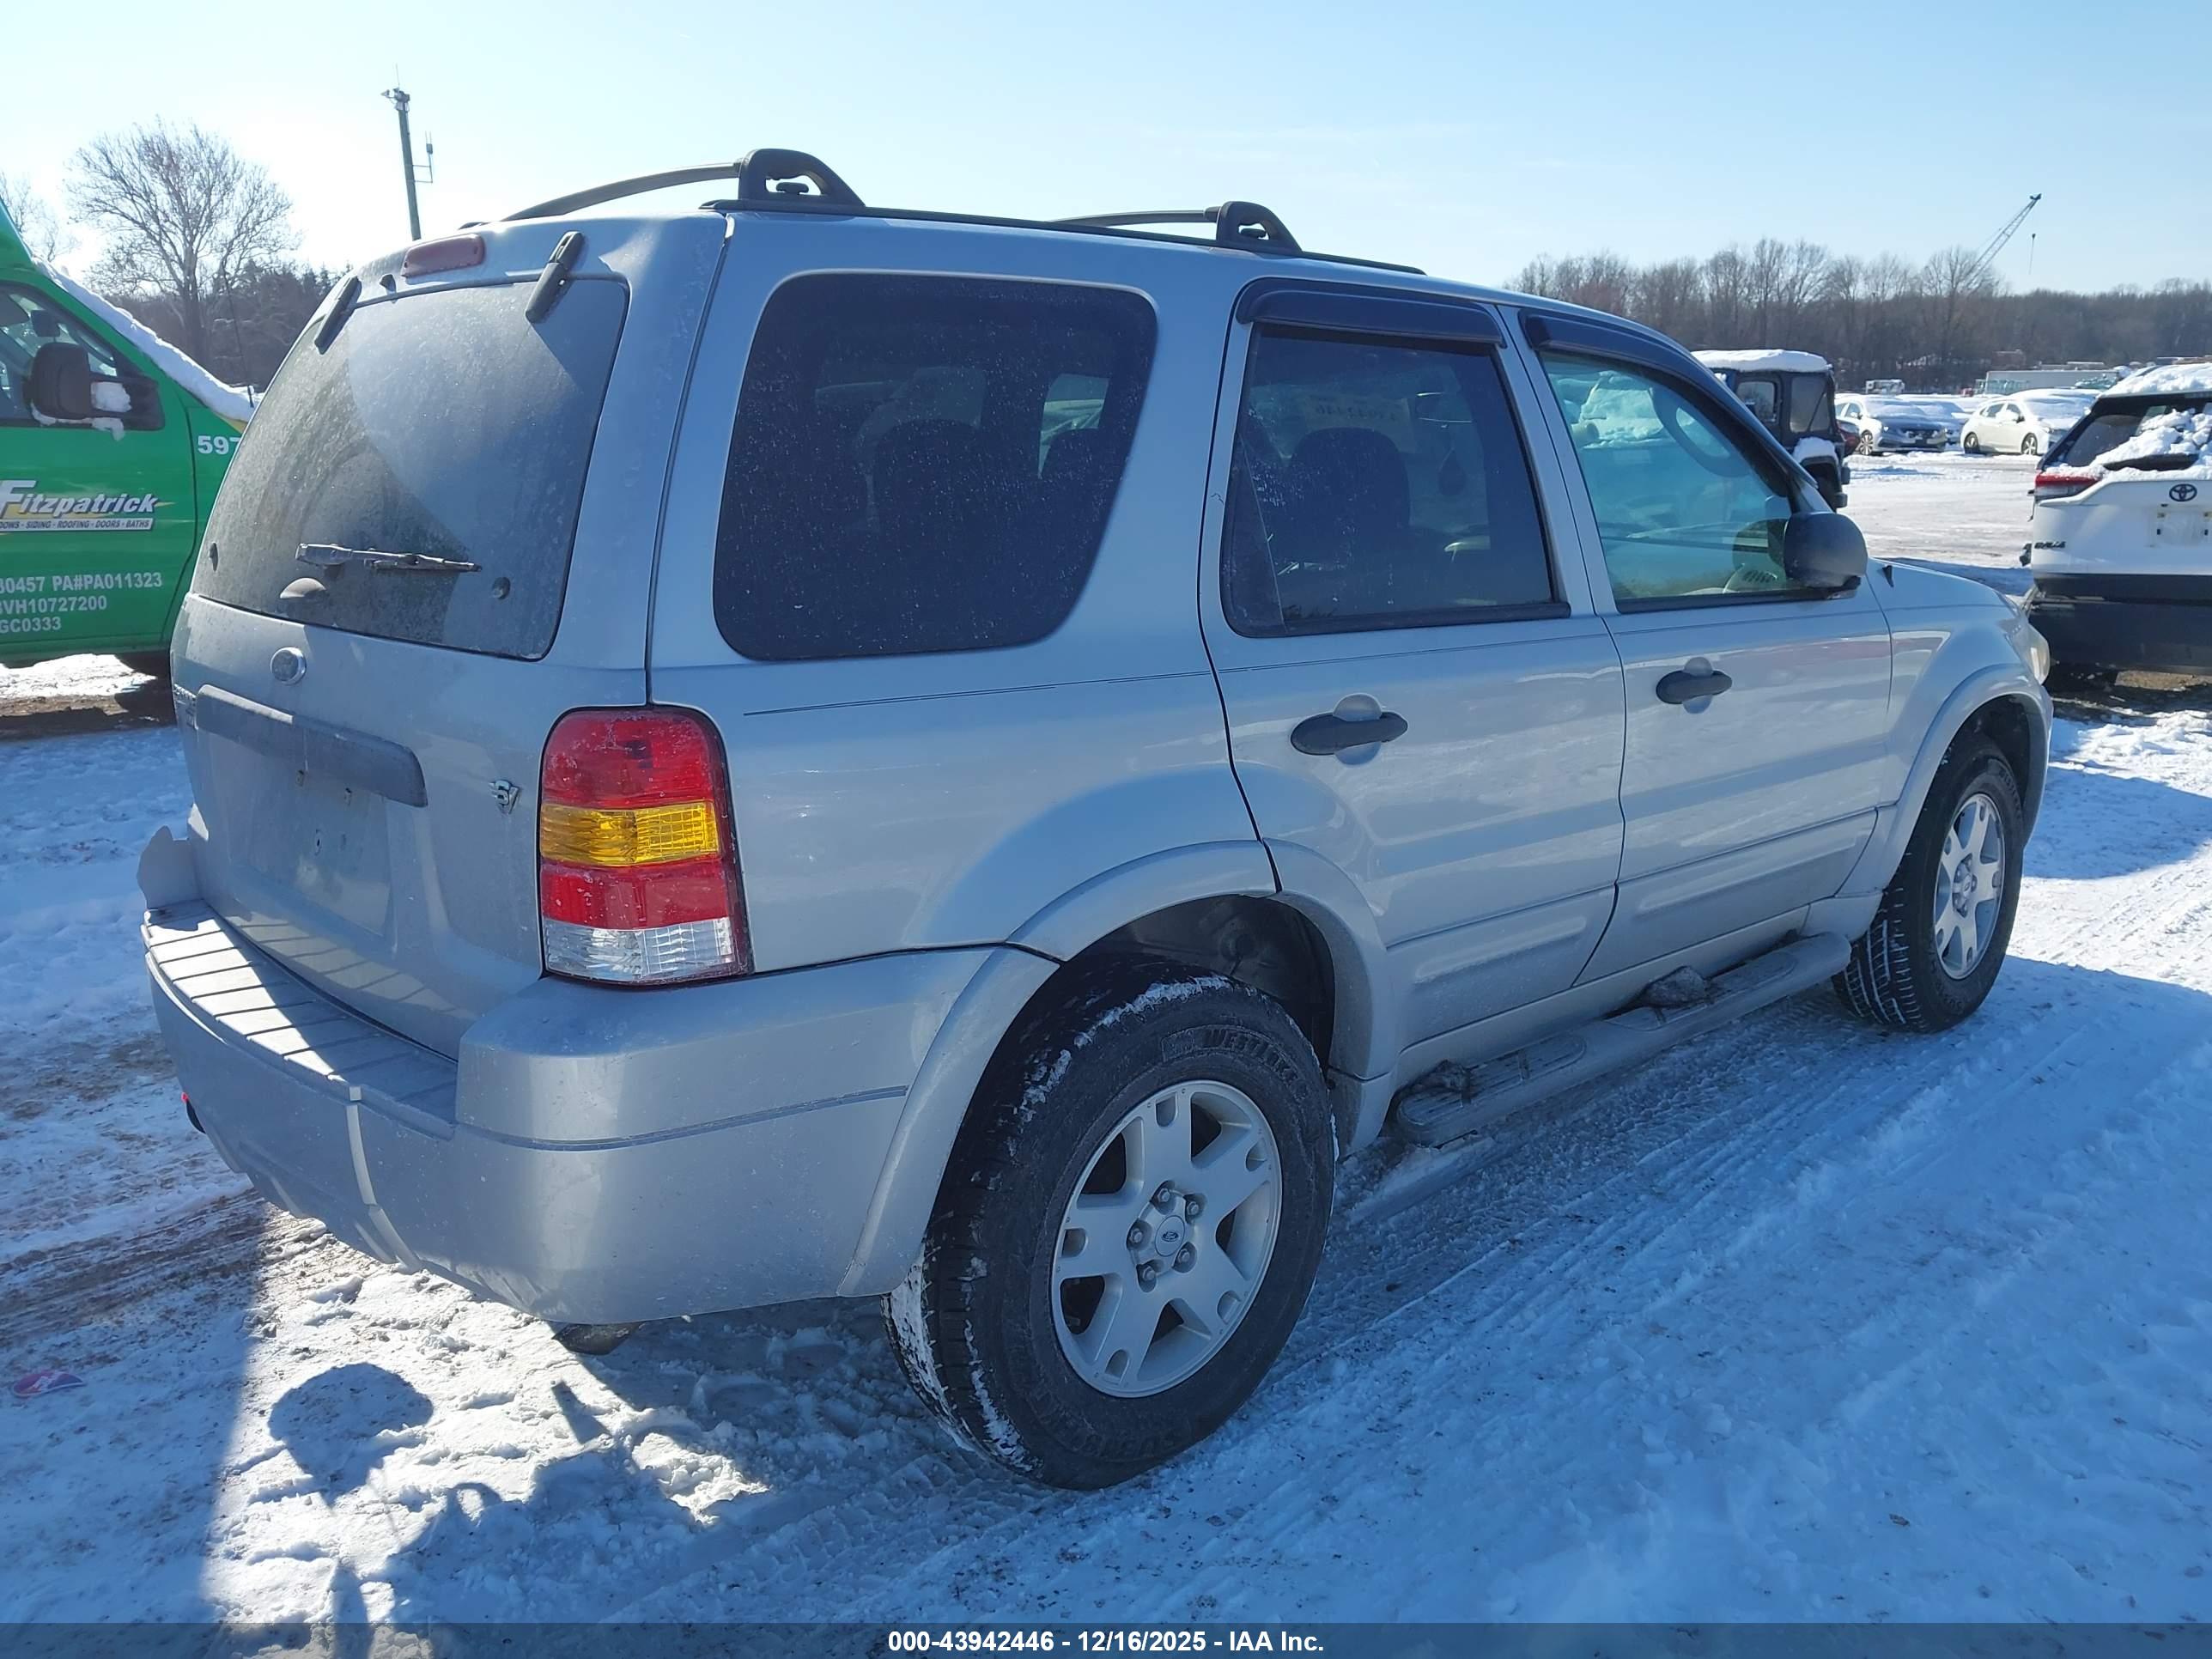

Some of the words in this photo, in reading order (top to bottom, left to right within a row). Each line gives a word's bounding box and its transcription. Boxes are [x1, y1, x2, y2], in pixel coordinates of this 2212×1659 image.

[0, 479, 158, 518] Fitzpatrick
[27, 520, 52, 529] SIDING
[57, 520, 90, 529] ROOFING
[94, 520, 121, 528] DOORS
[126, 520, 150, 528] BATHS
[52, 572, 162, 591] PA#PA011323
[0, 595, 107, 615] VH10727200
